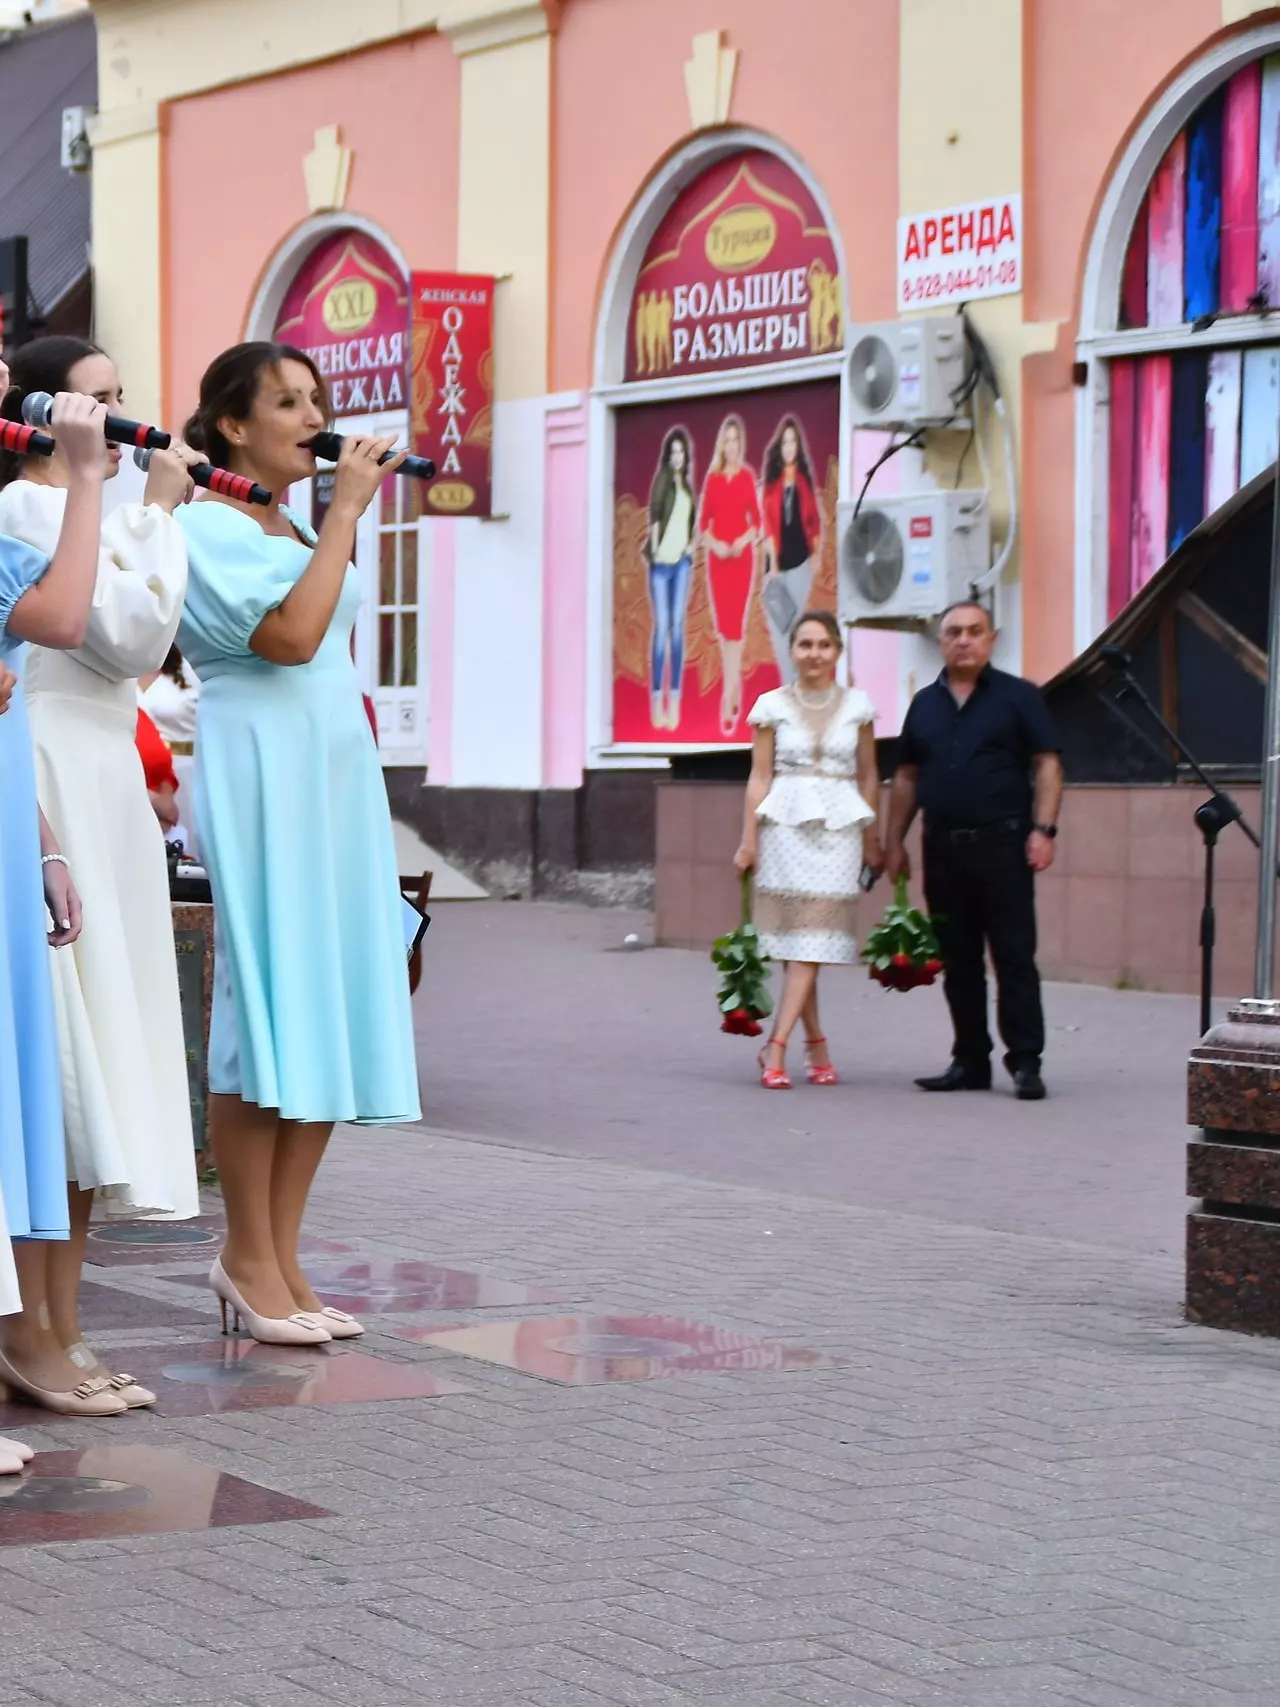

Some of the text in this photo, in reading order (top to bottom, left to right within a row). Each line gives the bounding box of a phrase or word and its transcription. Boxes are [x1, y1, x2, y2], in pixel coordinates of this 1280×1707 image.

[711, 224, 772, 256] Турция
[904, 202, 1015, 261] АРЕНДА
[420, 288, 487, 304] ЖЕНСКАЯ
[673, 267, 809, 321] БОЛЬШИЕ
[903, 260, 1017, 301] 8-928-044-01-08
[328, 290, 371, 322] XXL
[673, 312, 809, 364] РАЗМЕРЫ
[330, 371, 404, 411] ЕЖДА
[438, 306, 466, 473] ОДЕЖДА
[434, 486, 467, 501] XXL
